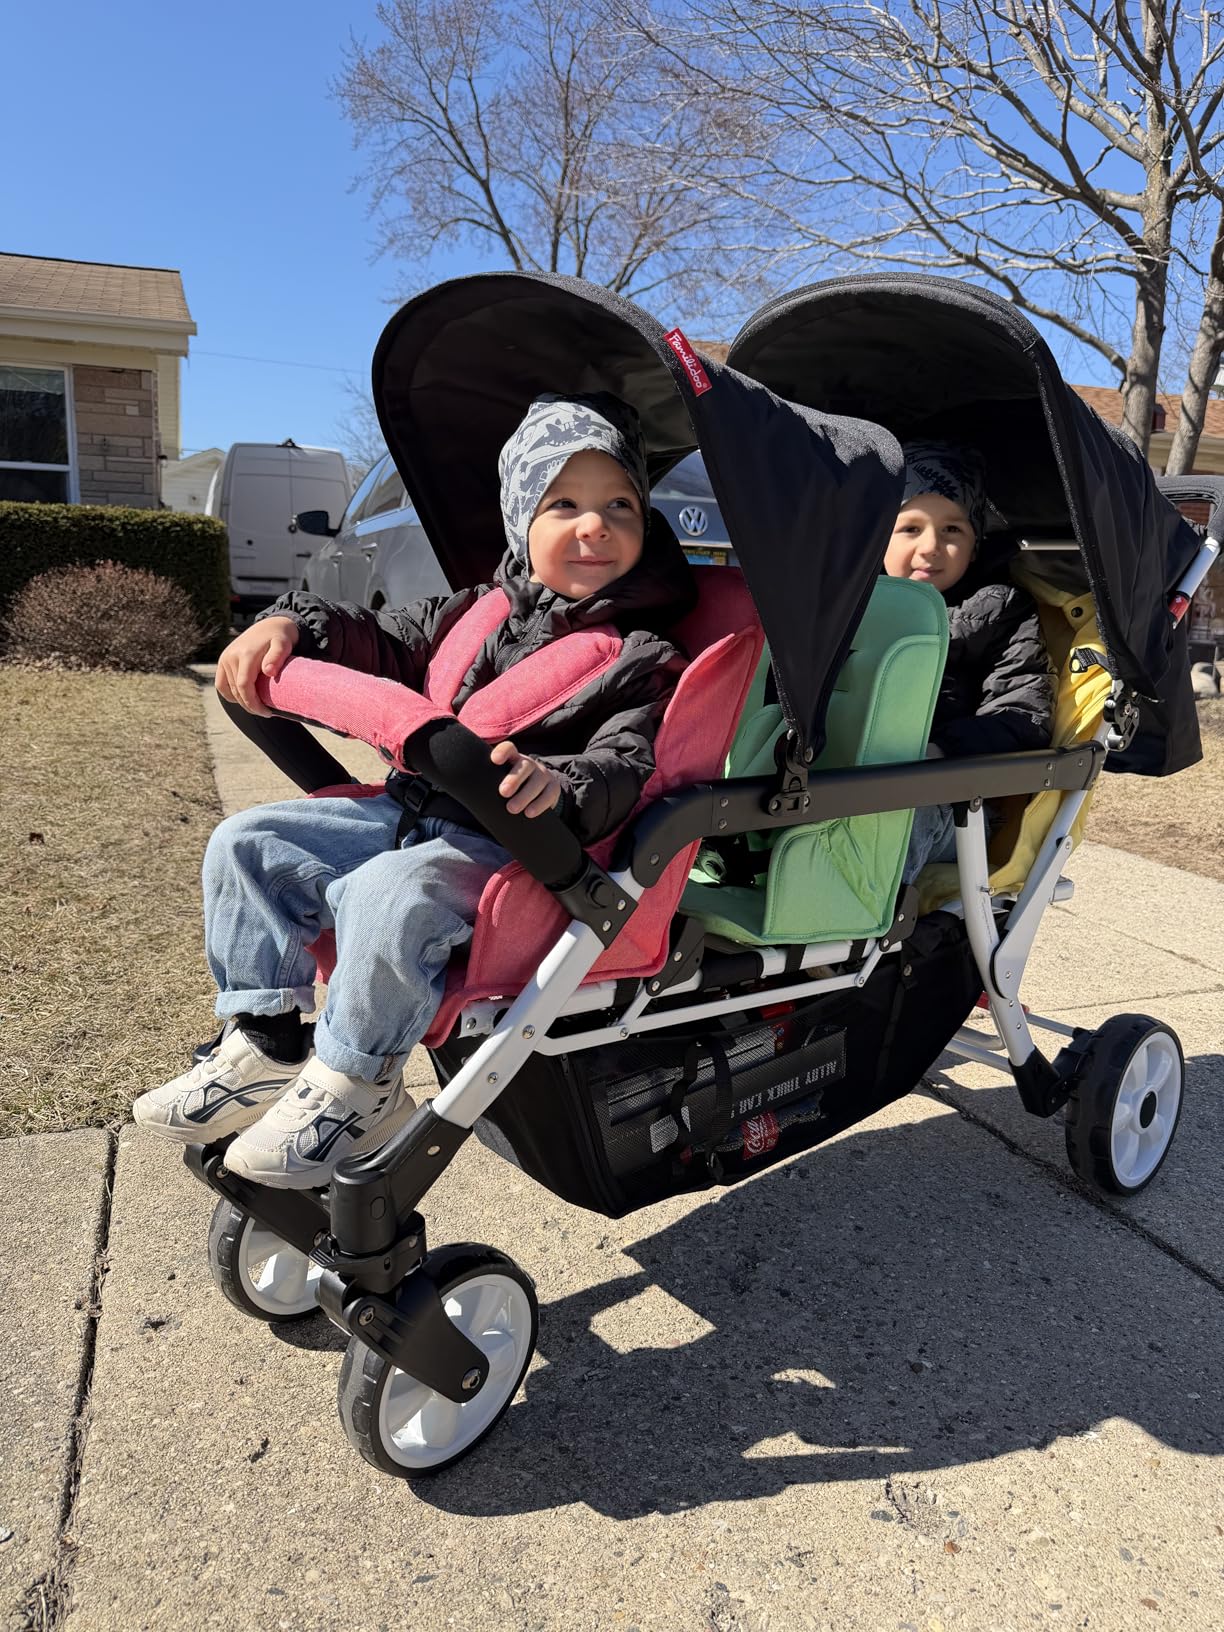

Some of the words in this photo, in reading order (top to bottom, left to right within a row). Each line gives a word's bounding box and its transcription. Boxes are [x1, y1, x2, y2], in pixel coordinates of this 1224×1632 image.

[669, 332, 703, 389] Familidoo
[680, 506, 707, 535] VW
[767, 1076, 801, 1102] TRUCK
[739, 1092, 762, 1114] CAR
